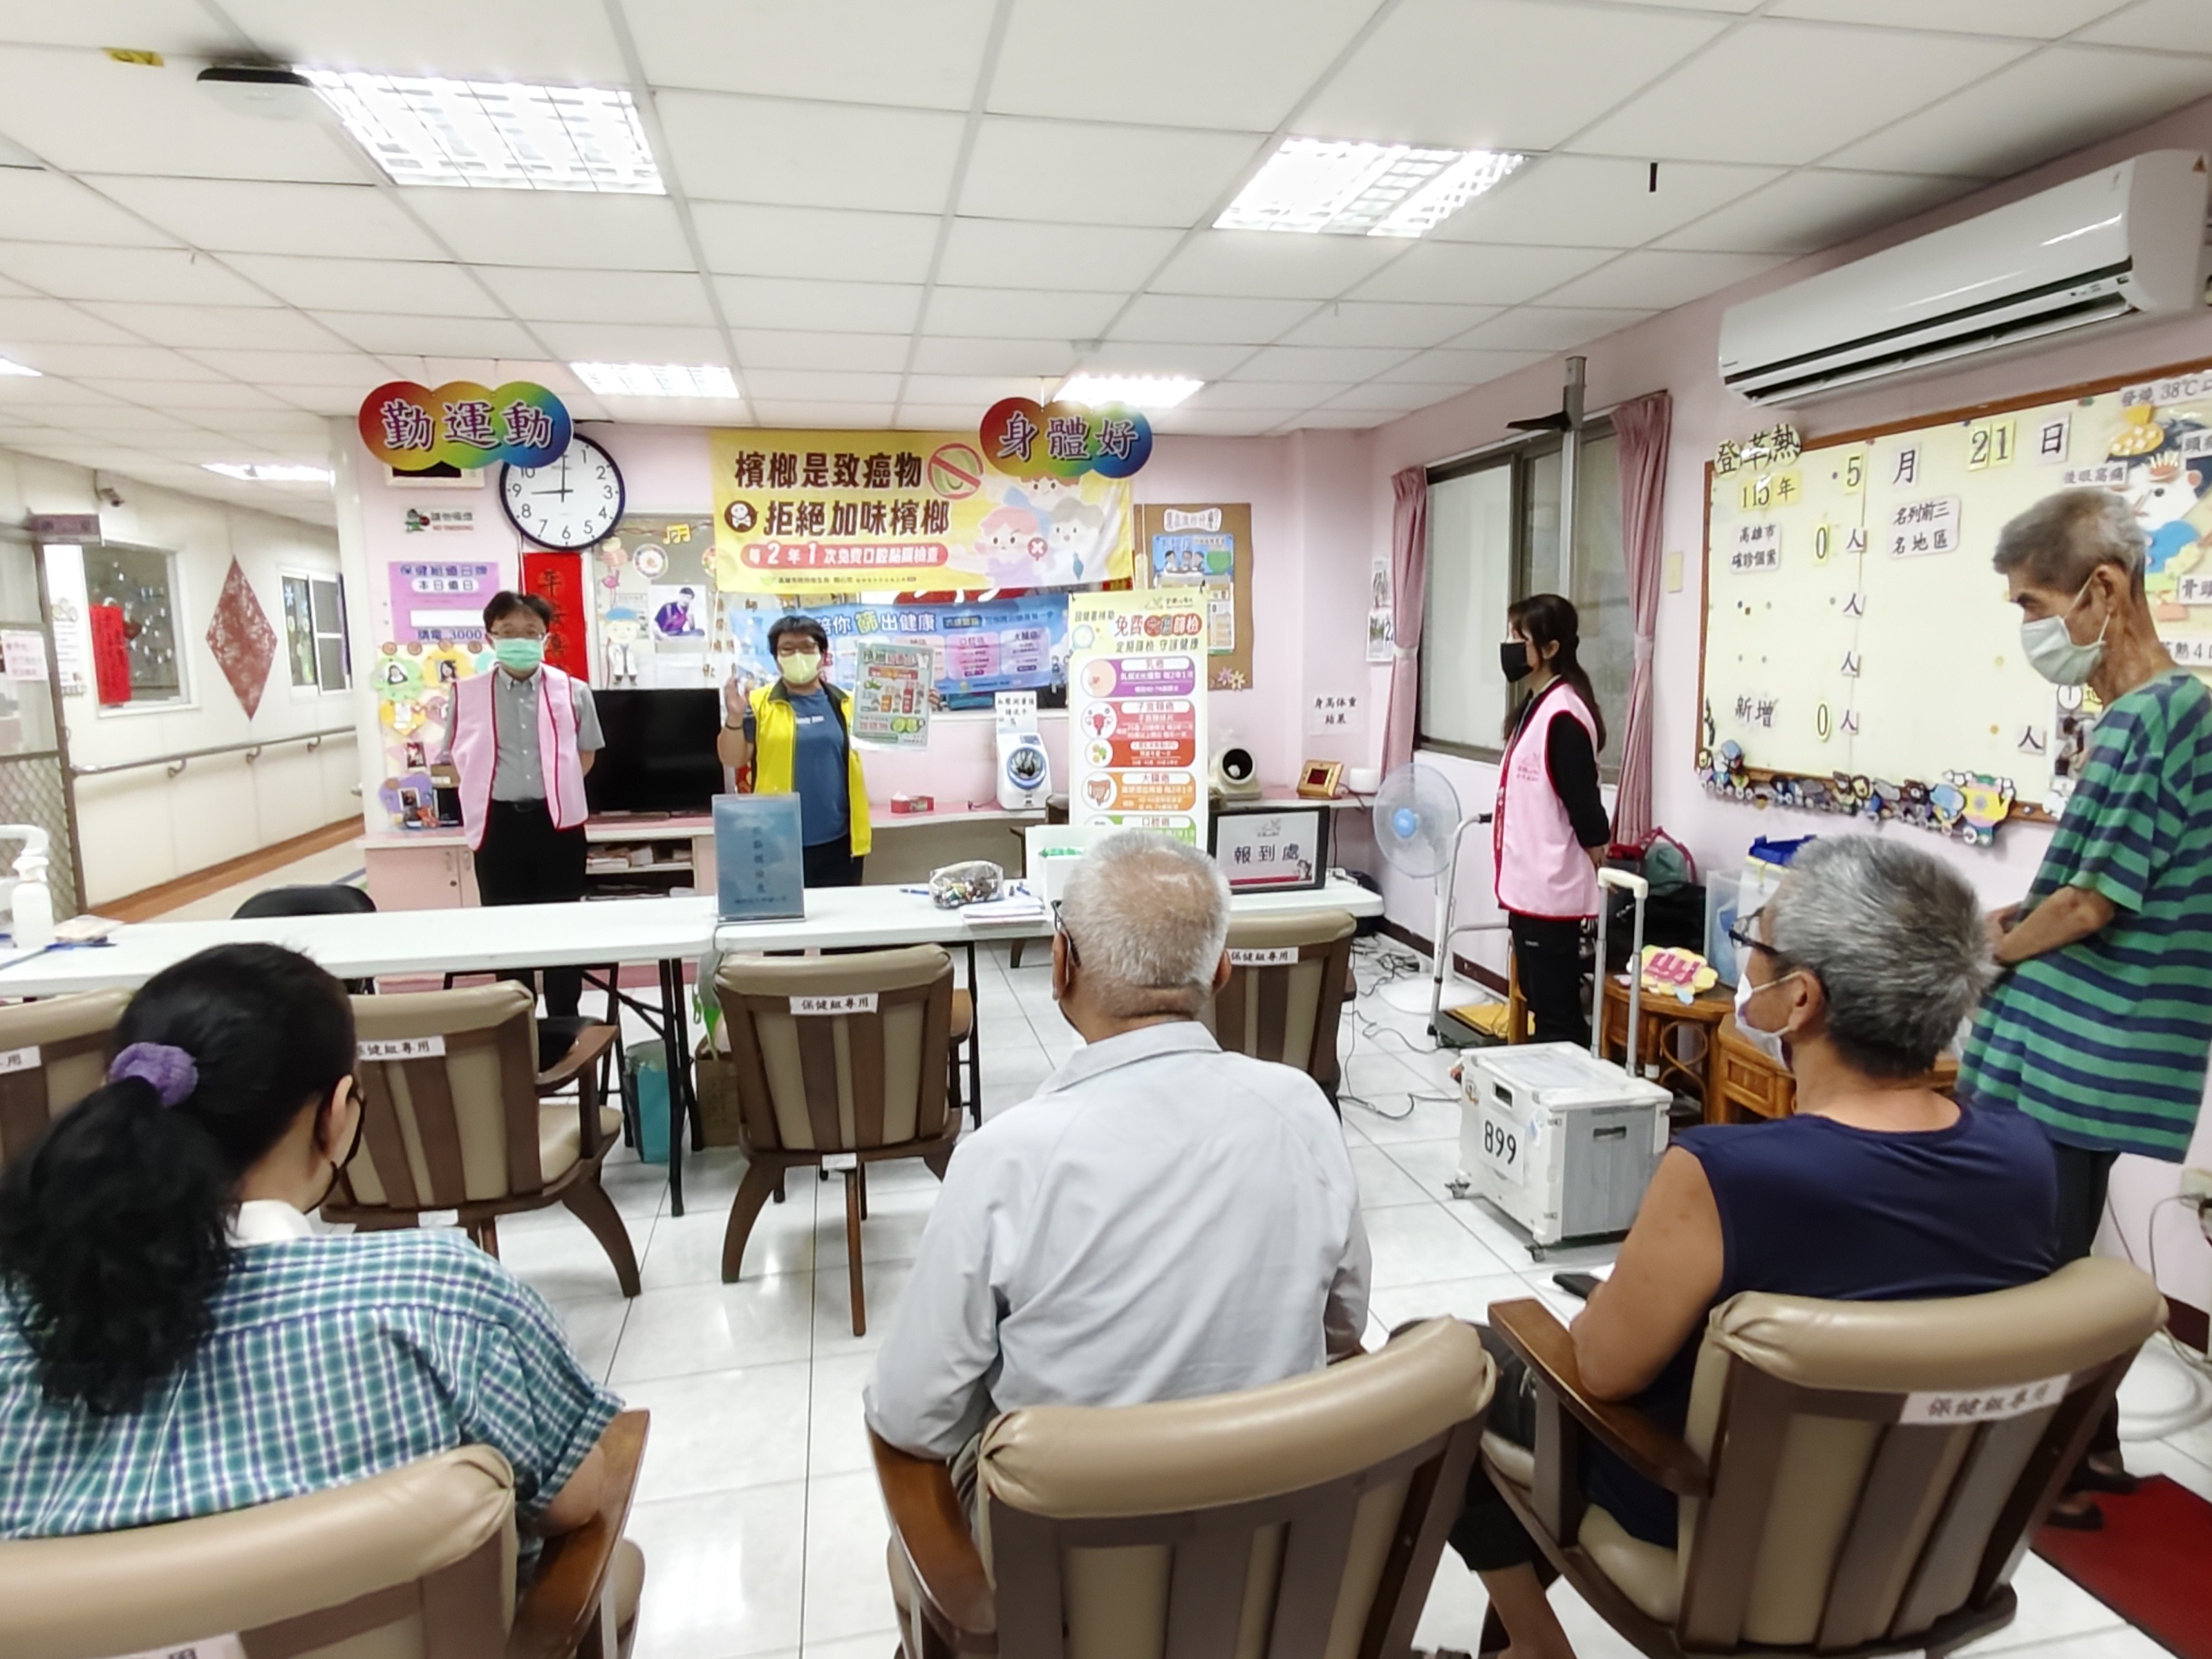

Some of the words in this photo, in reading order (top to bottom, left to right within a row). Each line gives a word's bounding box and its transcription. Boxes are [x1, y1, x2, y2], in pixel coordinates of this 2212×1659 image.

[379, 397, 555, 451] 勤運動
[997, 410, 1140, 462] 身體好
[581, 449, 588, 464] 1
[1716, 422, 1801, 476] 登革熱
[1846, 455, 1862, 487] 5
[1893, 449, 1917, 485] 月
[1970, 426, 2009, 465] 21
[2041, 422, 2063, 455] 日
[595, 465, 606, 480] 2
[734, 450, 924, 490] 檳榔是致癌物
[512, 482, 523, 498] 9
[603, 485, 614, 500] 3
[521, 503, 532, 518] 8
[598, 506, 608, 519] 4
[762, 499, 950, 538] 拒絕加味檳榔
[1893, 500, 1950, 525] 名列前三
[539, 519, 548, 534] 7
[561, 525, 571, 540] 6
[583, 520, 594, 534] 5
[1738, 523, 1777, 543] 高雄市
[1846, 533, 1864, 551] 人
[1893, 528, 1948, 554] 名地區
[1844, 592, 1864, 616] 人
[449, 628, 483, 641] 3000
[1841, 650, 1861, 677] 人
[1324, 712, 1347, 725] 結果
[1734, 695, 1779, 729] 新增
[1839, 709, 1859, 735] 人
[2017, 722, 2045, 751] 人
[1234, 842, 1300, 865] 報到處
[801, 996, 869, 1011] 保健組專用
[1484, 1118, 1517, 1165] 899
